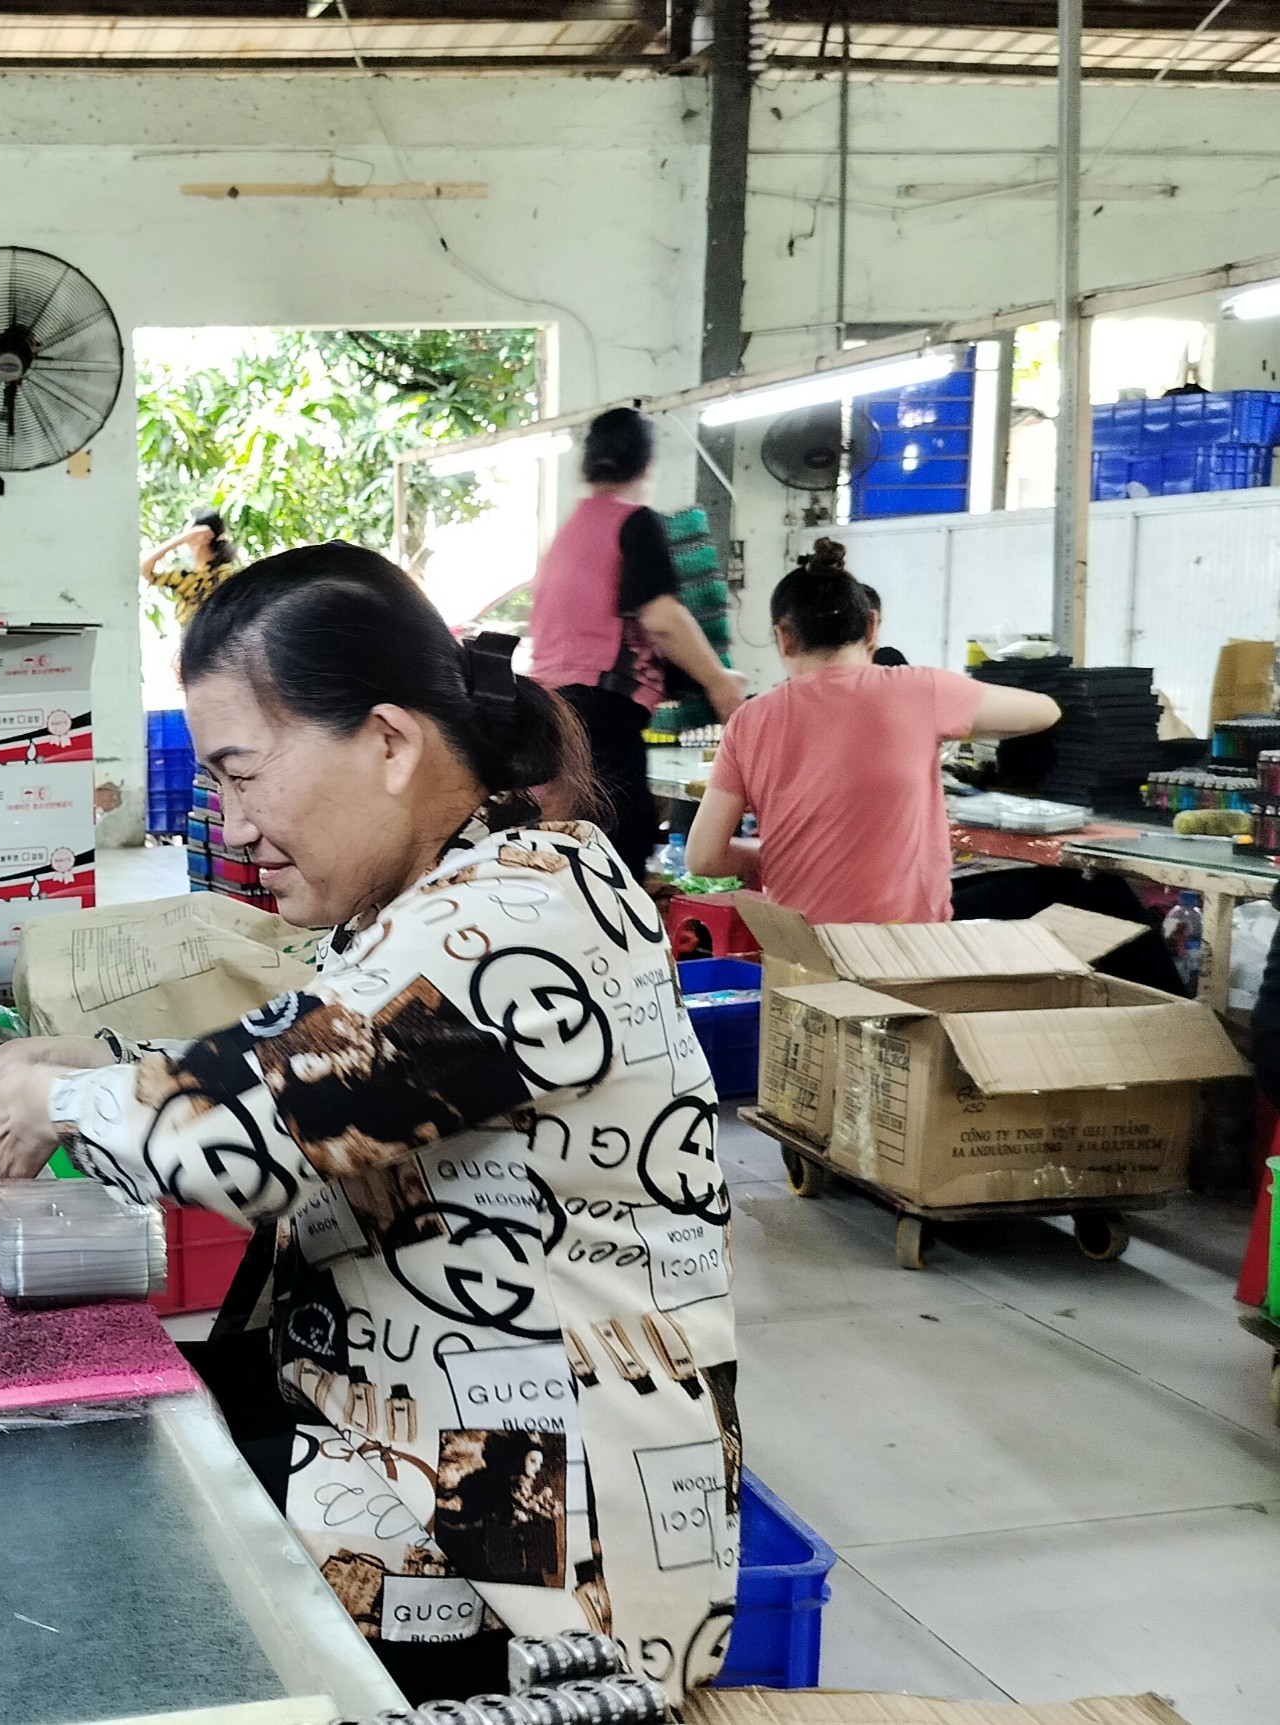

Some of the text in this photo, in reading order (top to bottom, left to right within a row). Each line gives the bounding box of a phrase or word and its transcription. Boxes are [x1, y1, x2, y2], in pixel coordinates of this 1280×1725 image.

[437, 1160, 529, 1182] GUCC
[502, 1416, 565, 1432] BLOOM
[394, 1602, 473, 1622] GUCC
